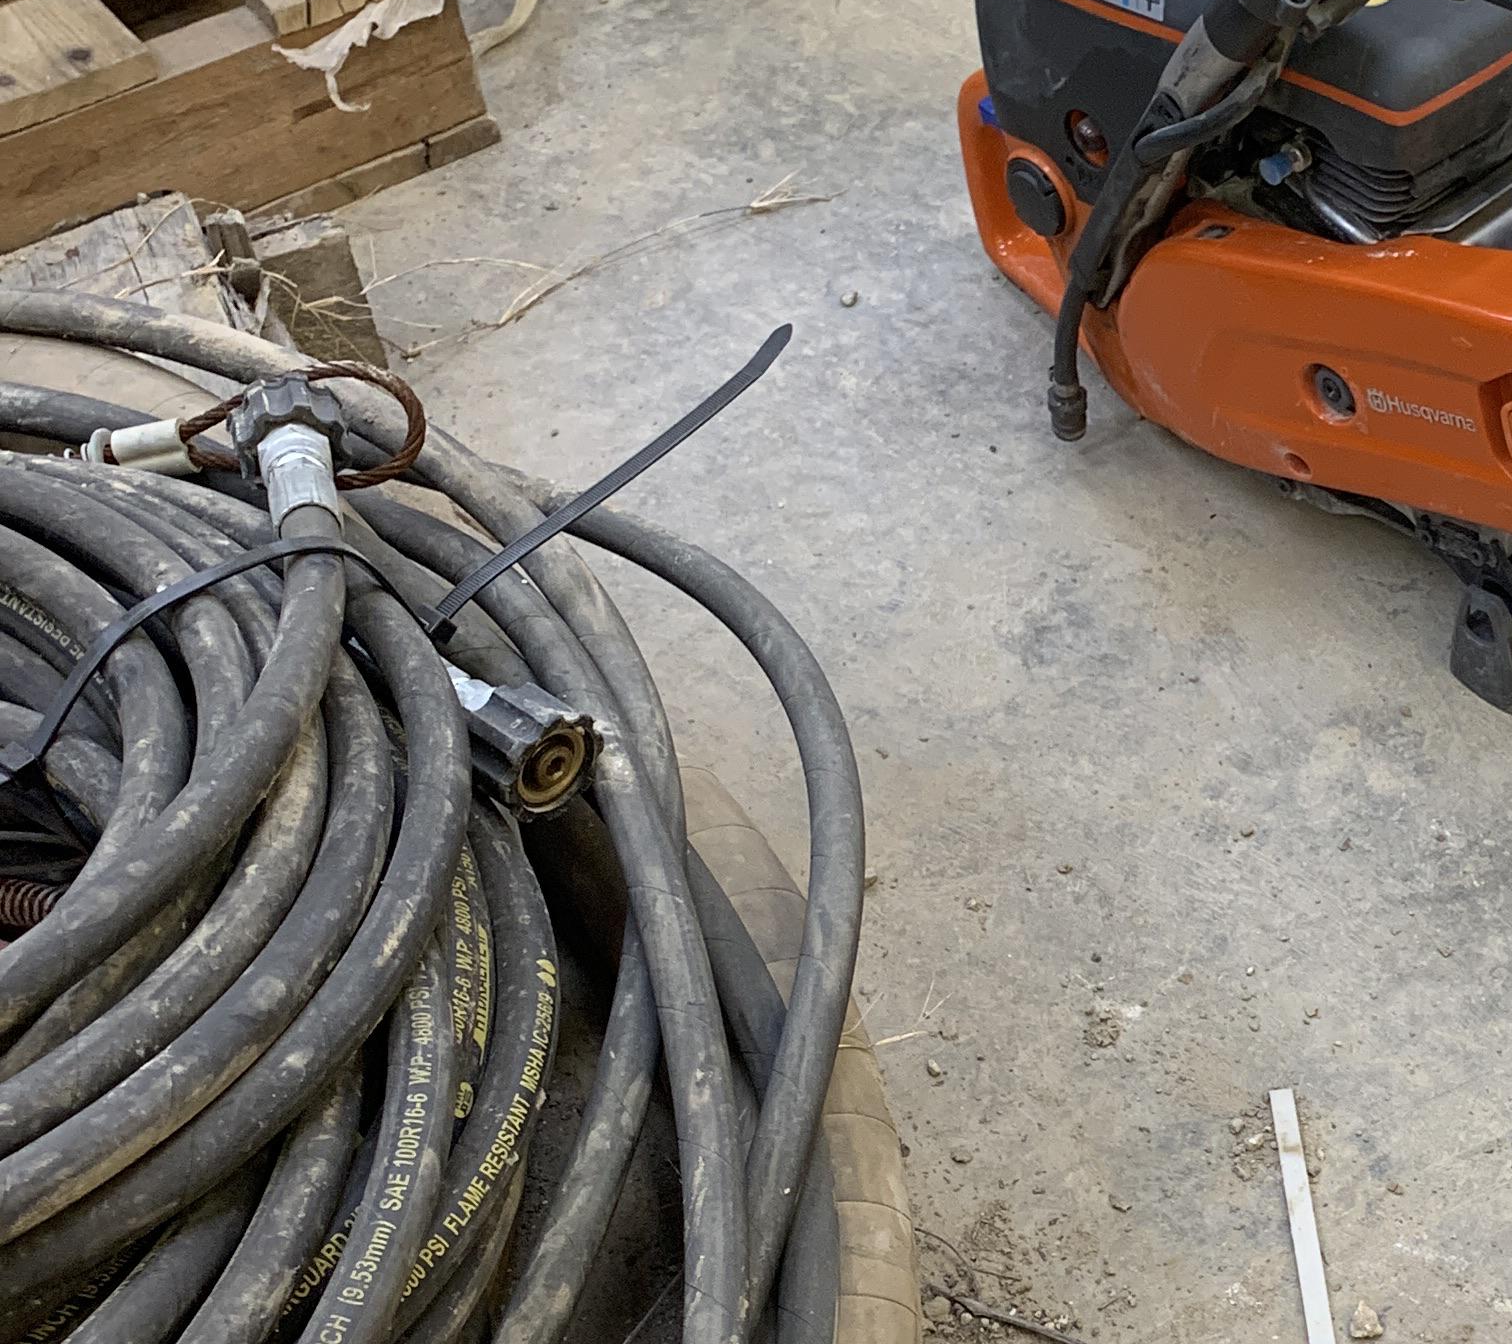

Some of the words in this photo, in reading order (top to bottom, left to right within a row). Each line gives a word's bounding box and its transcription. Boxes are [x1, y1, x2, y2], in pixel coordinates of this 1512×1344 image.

[1385, 394, 1477, 433] Husqvarna
[452, 875, 467, 900] PSI
[456, 902, 471, 935] 4800
[409, 987, 431, 1010] PSI
[411, 1012, 433, 1046] 4800
[393, 1092, 429, 1167] 100R16-6
[420, 1233, 450, 1268] PSI
[443, 1178, 492, 1236] FLAME
[479, 1092, 531, 1178] RESISTANT
[520, 1046, 547, 1094] MSHA
[379, 1170, 411, 1212] SAE
[337, 1220, 397, 1306] (9.53mm)
[27, 1304, 79, 1341] INCH
